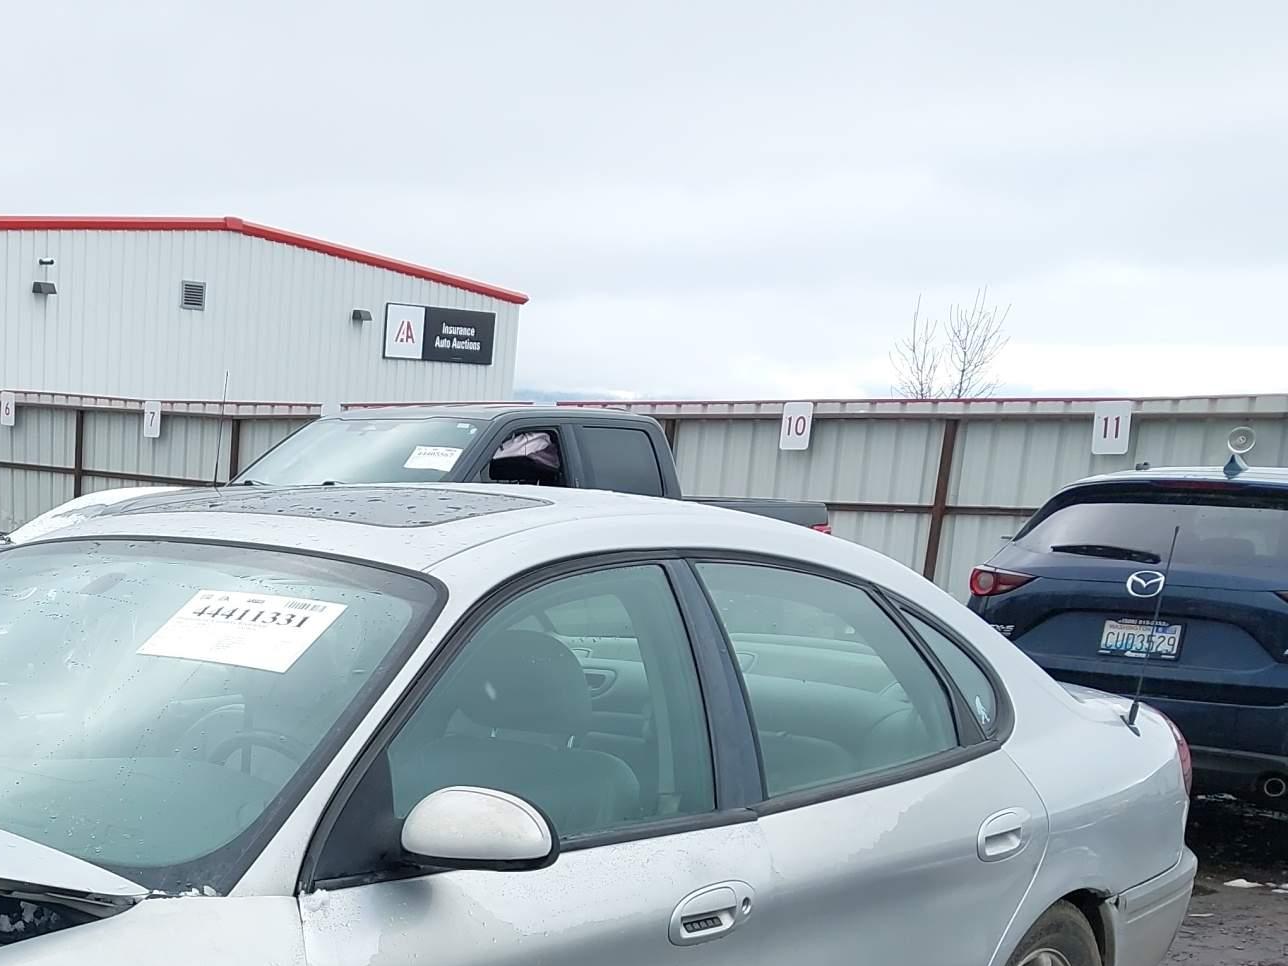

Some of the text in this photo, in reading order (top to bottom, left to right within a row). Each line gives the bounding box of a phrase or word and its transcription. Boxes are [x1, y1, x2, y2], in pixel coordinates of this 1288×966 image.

[441, 322, 476, 336] Insurance
[434, 335, 481, 351] Auto Auctions
[5, 403, 10, 415] 6
[150, 411, 156, 427] 7
[787, 415, 806, 436] 10
[1103, 416, 1120, 439] 11
[192, 604, 311, 628] 44411331
[1104, 631, 1177, 653] CUD3529
